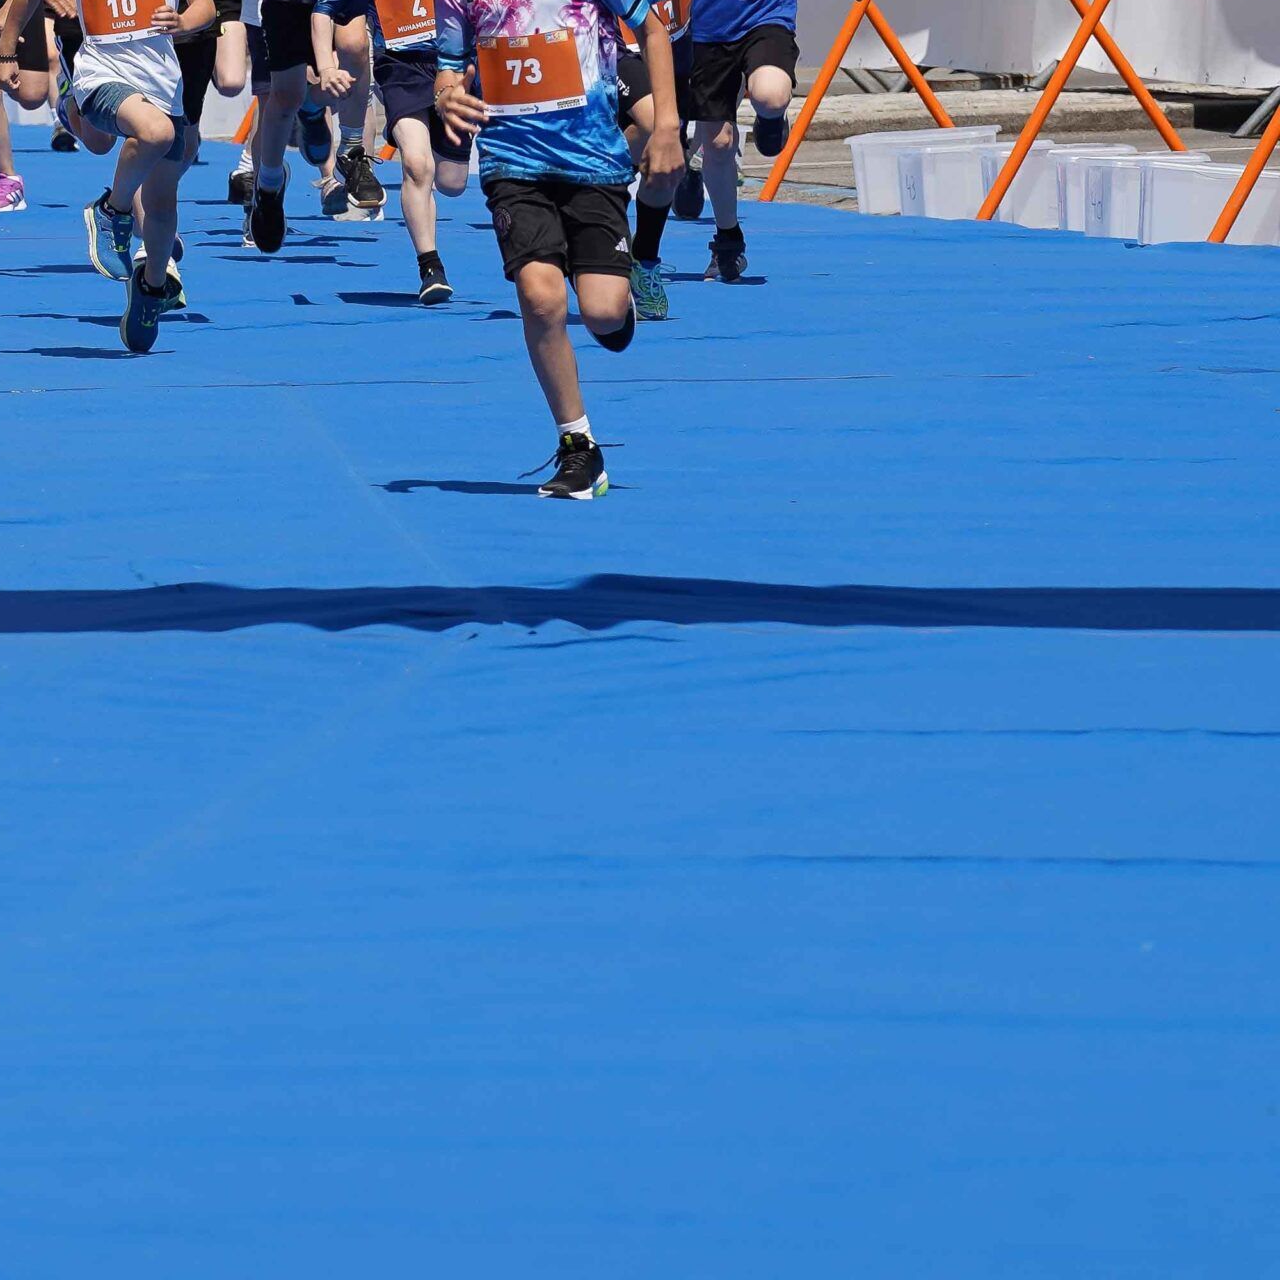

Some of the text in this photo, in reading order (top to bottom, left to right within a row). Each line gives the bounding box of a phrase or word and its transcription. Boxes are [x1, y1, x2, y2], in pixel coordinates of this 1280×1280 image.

[111, 20, 136, 30] LUKAS
[397, 19, 436, 33] MUHAMMED
[506, 58, 543, 86] 73
